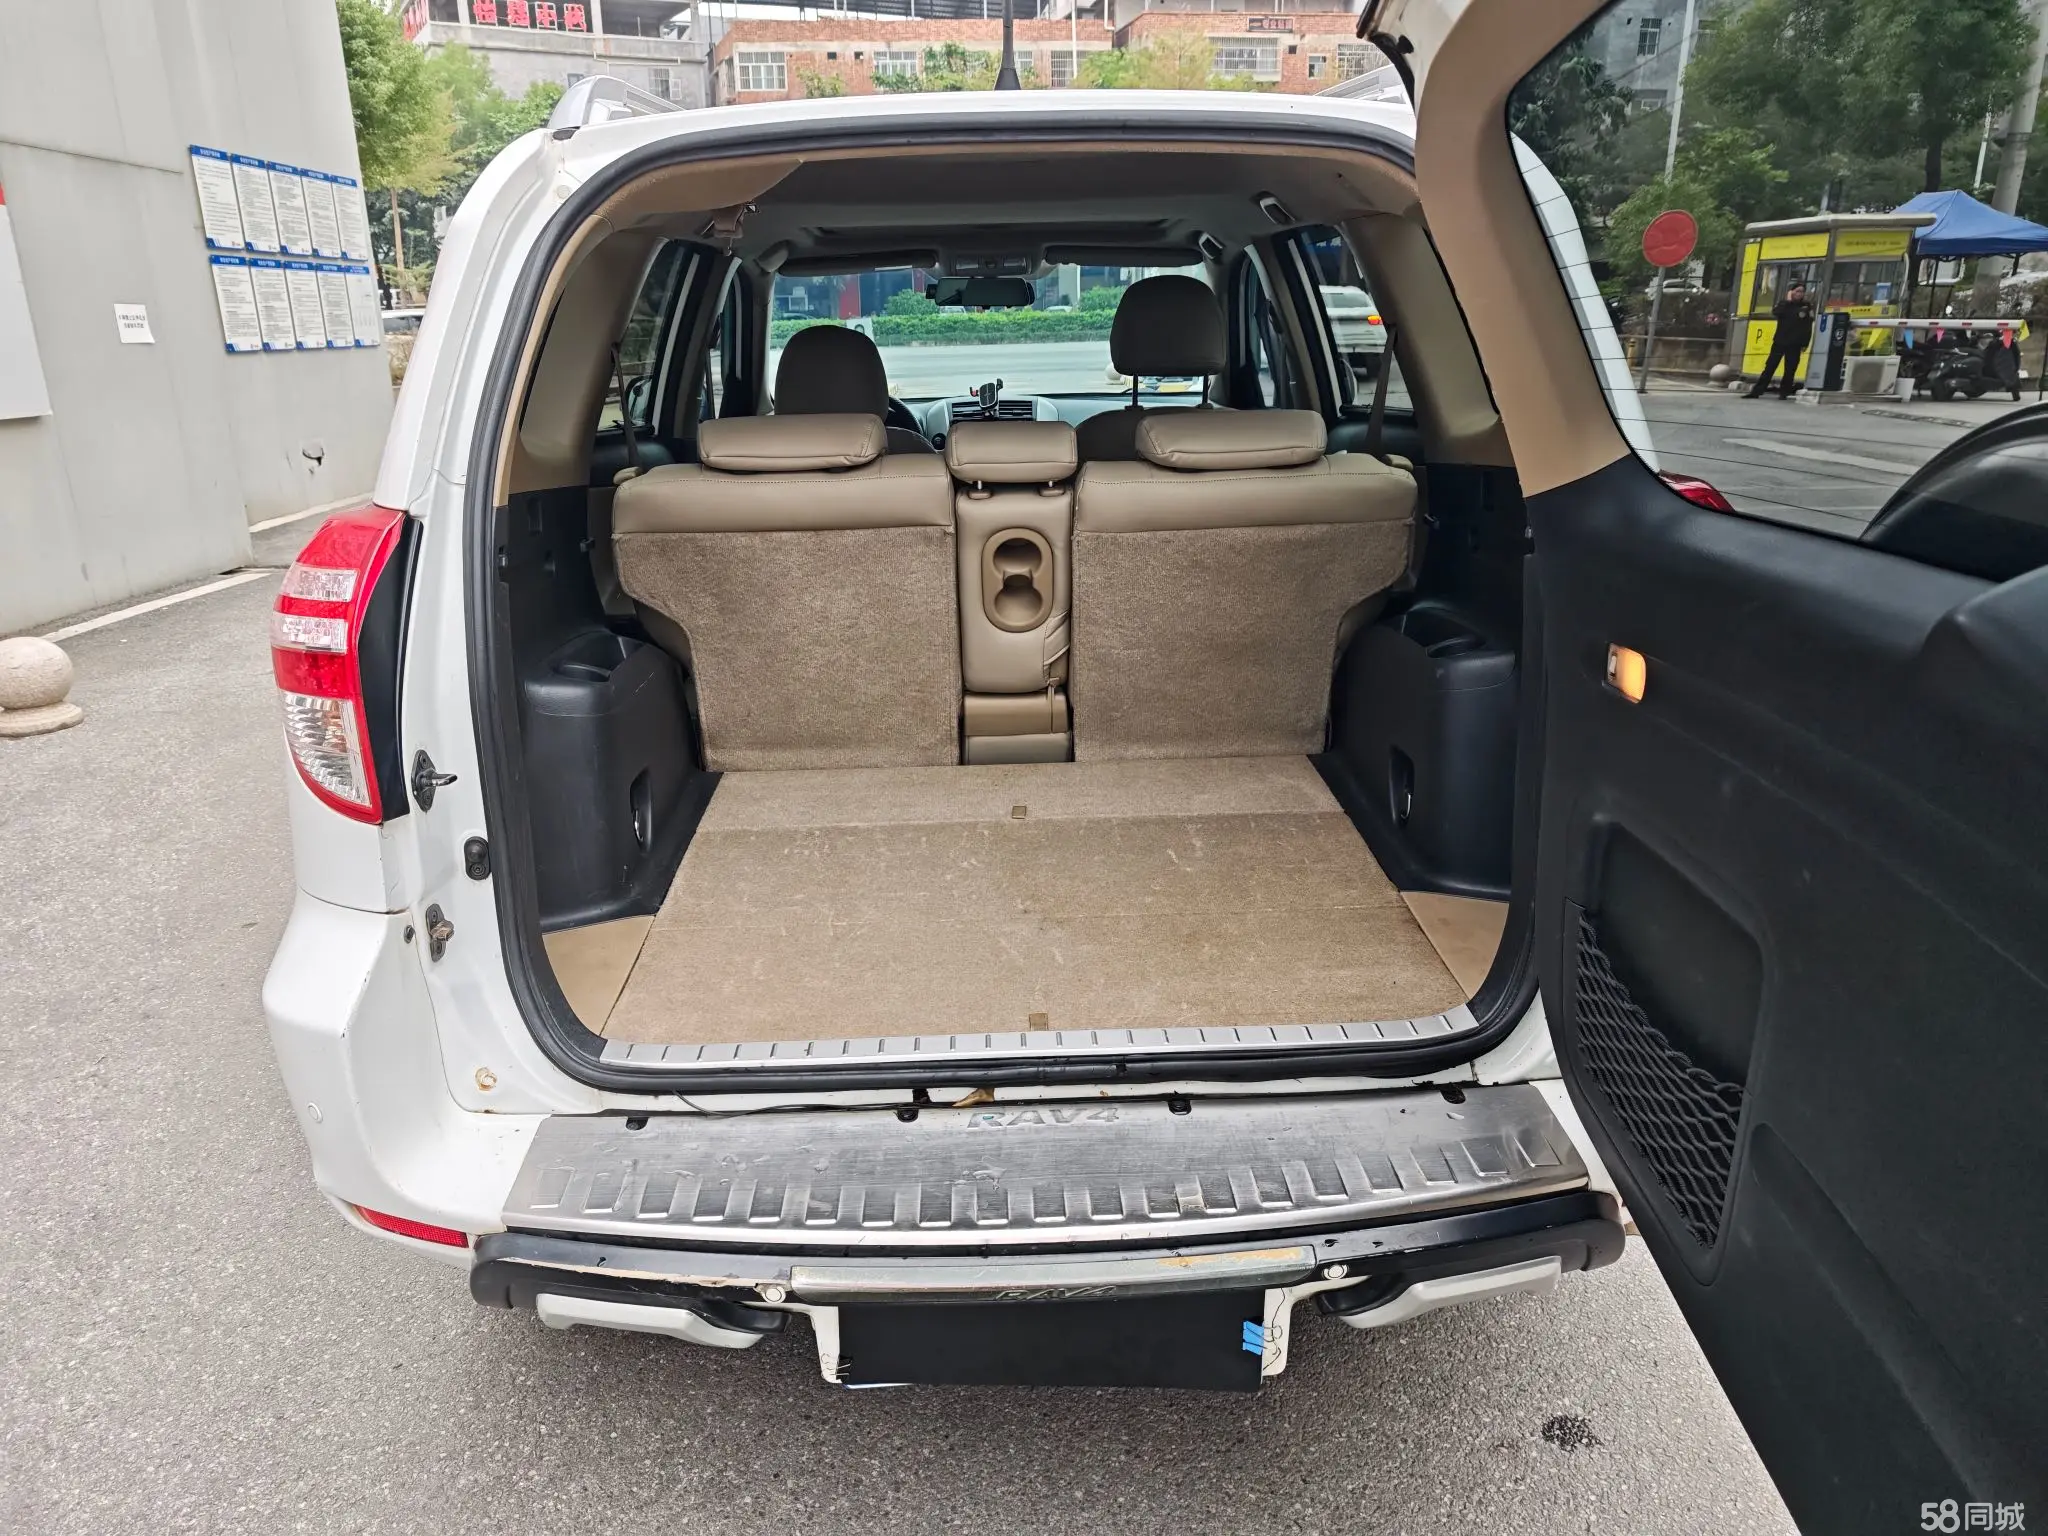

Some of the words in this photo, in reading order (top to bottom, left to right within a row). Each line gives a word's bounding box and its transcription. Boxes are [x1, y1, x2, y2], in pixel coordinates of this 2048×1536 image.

[1755, 328, 1763, 345] P
[967, 1107, 1120, 1128] RAV4
[995, 1286, 1117, 1301] RAV4
